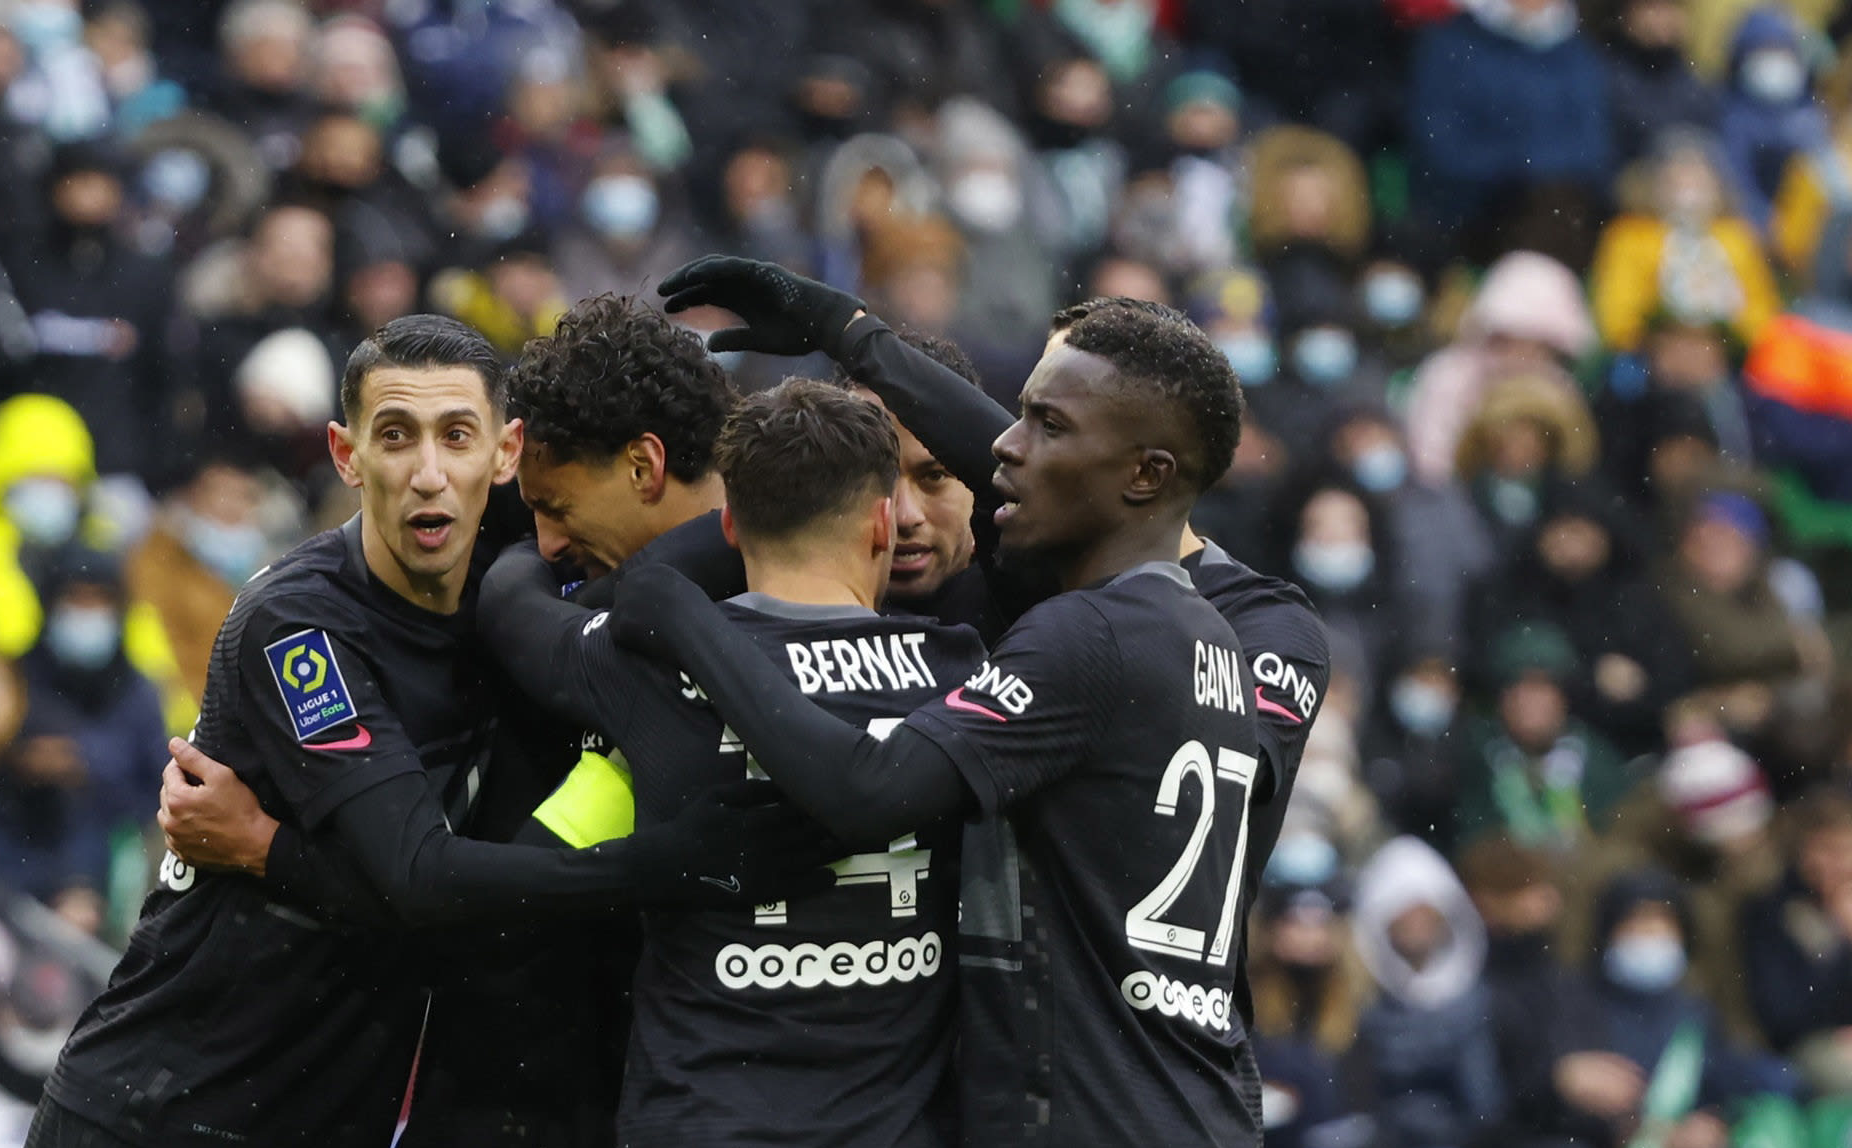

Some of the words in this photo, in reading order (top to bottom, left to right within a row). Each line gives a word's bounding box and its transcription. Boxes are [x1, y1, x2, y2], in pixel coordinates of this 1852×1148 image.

[786, 632, 938, 695] BERNAT
[1193, 639, 1246, 716] GANA
[1252, 651, 1318, 719] QNB
[297, 692, 331, 714] LIGUE
[299, 712, 321, 728] Uber
[320, 702, 346, 719] Eats
[1125, 739, 1258, 966] 27
[715, 931, 942, 990] ooredoo
